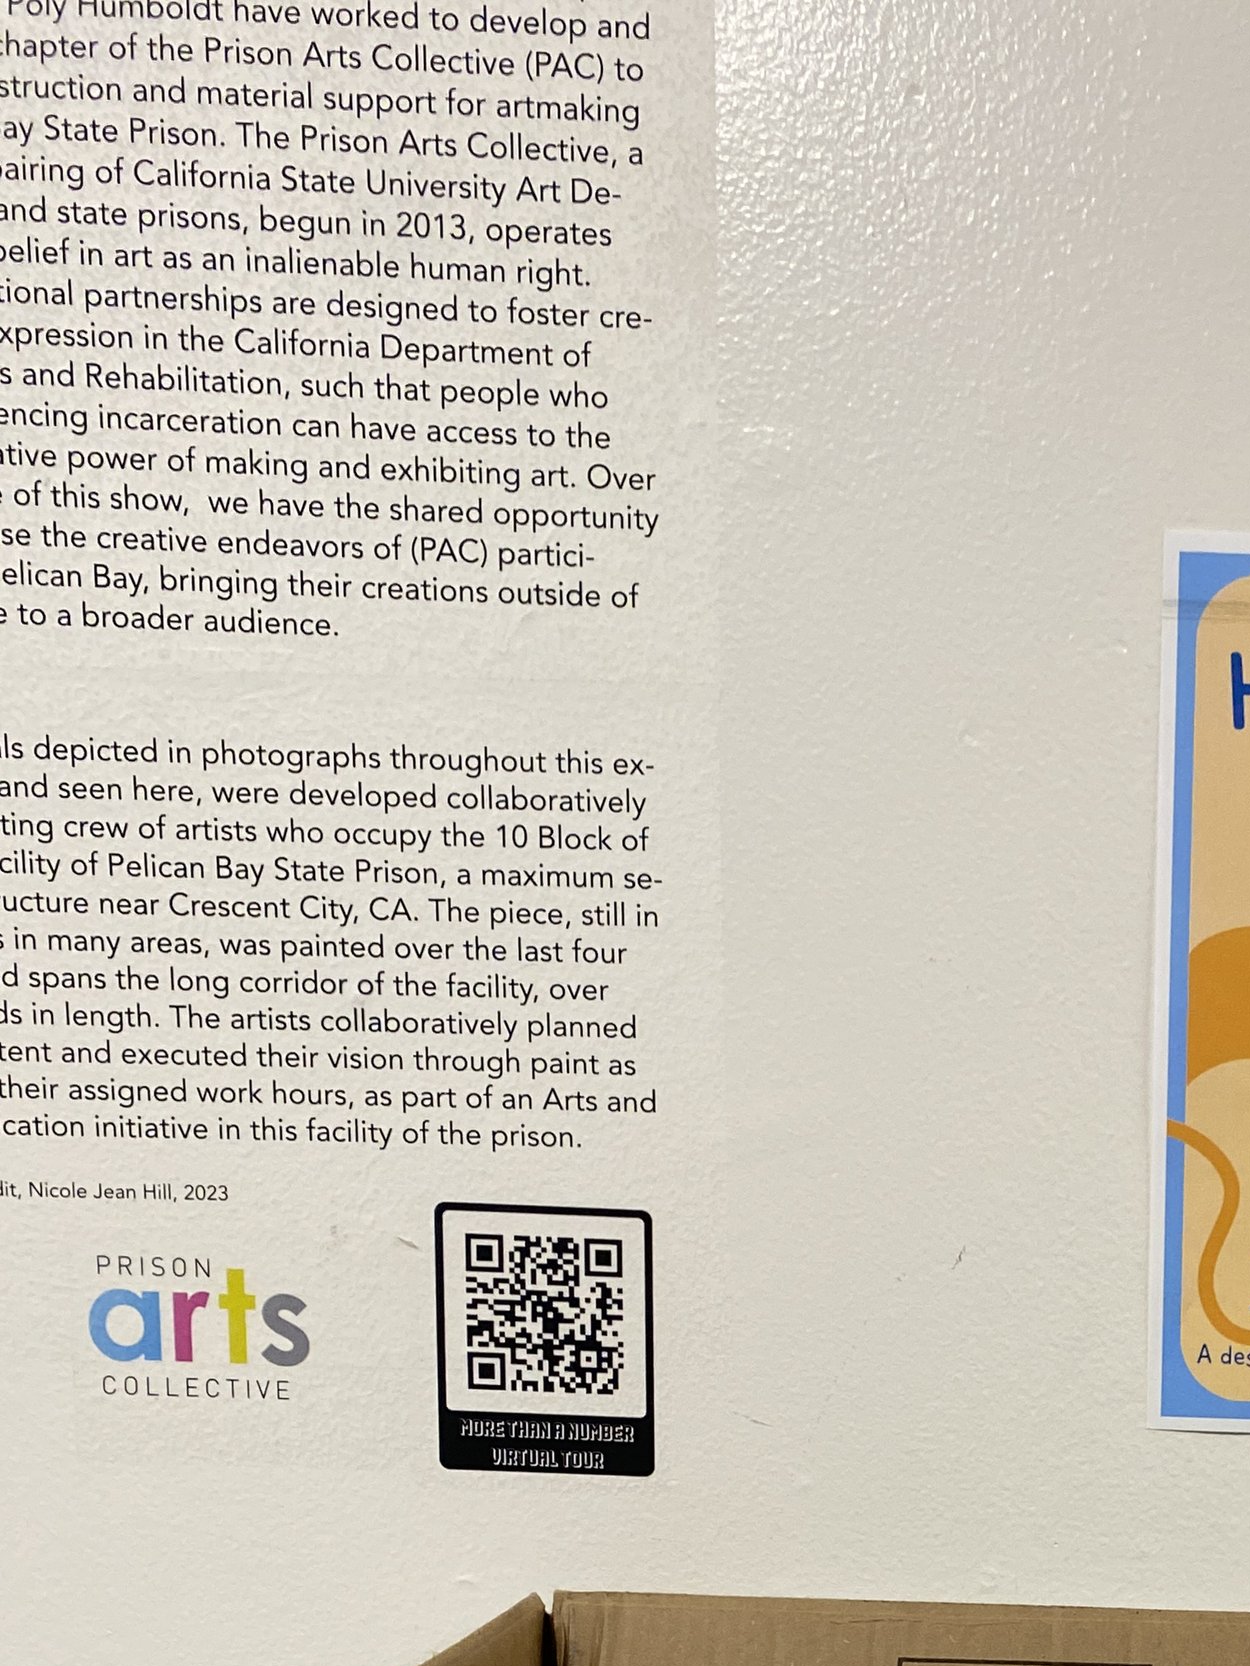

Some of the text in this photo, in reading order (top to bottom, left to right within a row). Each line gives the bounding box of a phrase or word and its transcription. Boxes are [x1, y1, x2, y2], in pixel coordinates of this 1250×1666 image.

[0, 28, 644, 85] hapter of the Prison Arts Collective (PAC) to
[43, 113, 119, 144] State
[129, 116, 226, 148] Prison.
[234, 120, 290, 151] The
[301, 124, 389, 155] Prison
[398, 128, 458, 158] Arts
[467, 131, 617, 170] Collective,
[628, 146, 644, 166] a
[0, 194, 612, 250] and state prisons, begun in 2013, operates
[143, 323, 168, 351] in
[177, 323, 225, 353] the
[234, 326, 370, 359] California
[380, 333, 554, 369] Department
[562, 340, 593, 368] of
[0, 400, 611, 450] encing incarceration can have access to the
[39, 520, 87, 549] the
[96, 526, 208, 554] creative
[217, 528, 364, 560] endeavors
[373, 533, 403, 561] of
[411, 535, 488, 569] (PAC)
[498, 541, 595, 573] partici-
[16, 600, 339, 637] to a broader audience.
[0, 772, 647, 822] and seen here, were developed collaboratively
[70, 850, 99, 877] of
[108, 851, 205, 879] Pelican
[215, 854, 265, 888] Bay
[274, 856, 345, 883] State
[355, 858, 446, 889] Prison,
[456, 868, 472, 886] a
[481, 862, 614, 889] maximum
[623, 872, 663, 891] se-
[2, 891, 659, 931] ucture near Crescent City, CA. The piece, still in
[31, 1001, 55, 1026] in
[64, 1000, 160, 1035] length.
[168, 1003, 221, 1030] The
[230, 1006, 312, 1032] artists
[320, 1006, 518, 1043] collaboratively
[527, 1011, 637, 1044] planned
[61, 1038, 112, 1065] and
[121, 1041, 247, 1068] executed
[255, 1042, 320, 1069] their
[326, 1045, 404, 1071] vision
[412, 1045, 521, 1080] through
[531, 1050, 600, 1081] paint
[608, 1058, 637, 1077] as
[2, 1112, 582, 1153] cation initiative in this facility of the prison.
[29, 1181, 87, 1199] Nicole
[93, 1183, 136, 1200] Jean
[143, 1184, 177, 1203] Hill,
[183, 1184, 229, 1201] 2023
[96, 1255, 211, 1278] PRISON
[88, 1268, 310, 1367] arts
[1197, 1344, 1213, 1365] A
[102, 1375, 290, 1400] COLLECTIVE
[460, 1418, 635, 1443] MORE THAN A NUMBER
[492, 1447, 605, 1470] VIRTUAL TOUR
